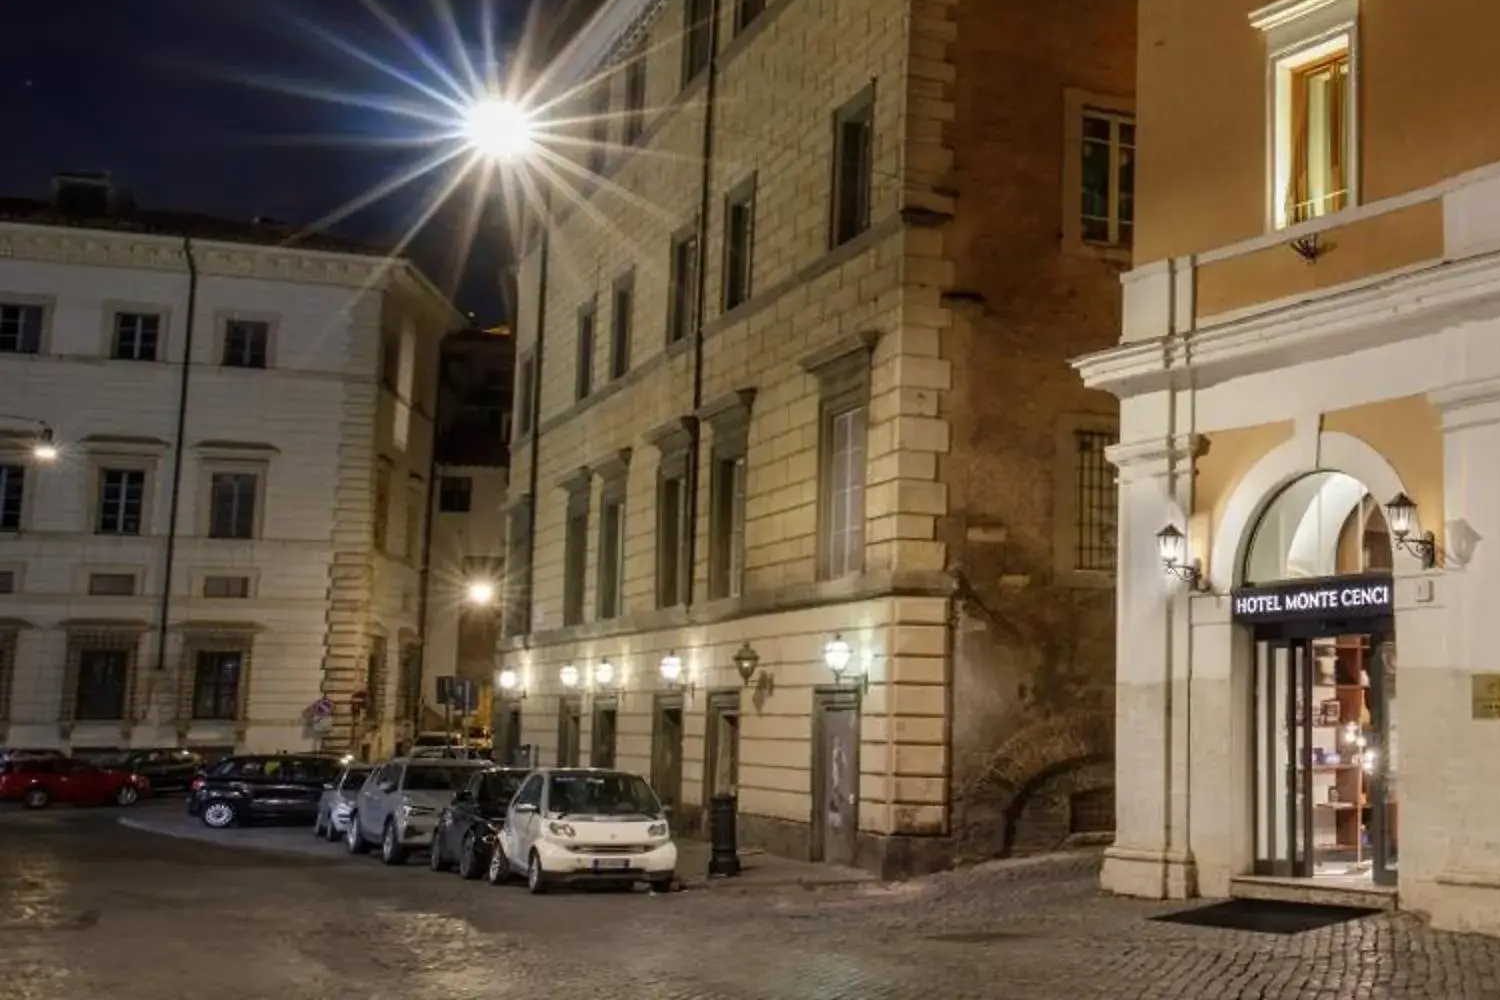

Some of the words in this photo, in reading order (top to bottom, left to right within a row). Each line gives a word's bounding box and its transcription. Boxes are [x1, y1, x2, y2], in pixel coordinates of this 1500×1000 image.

[1235, 594, 1282, 615] HOTEL
[1285, 589, 1339, 611] MONTE
[1340, 585, 1389, 607] CENCI
